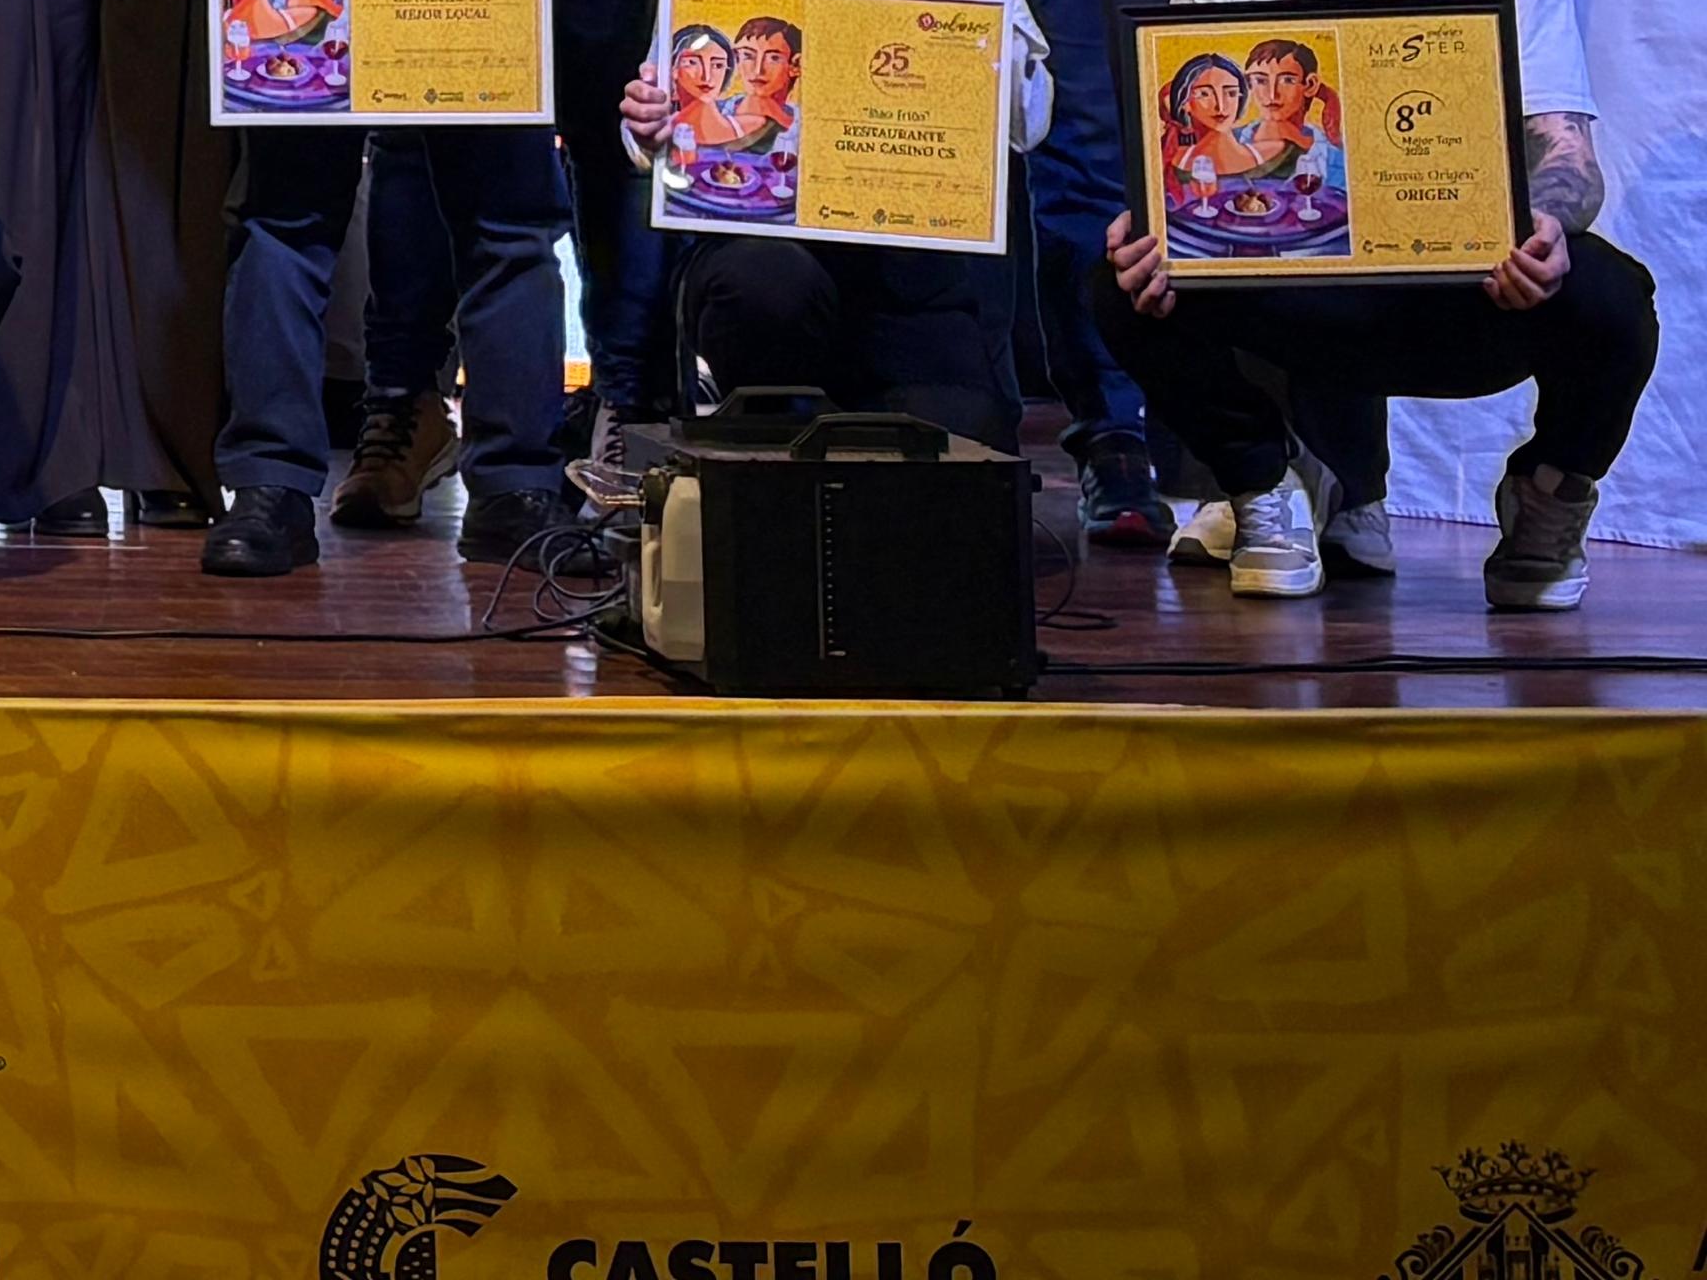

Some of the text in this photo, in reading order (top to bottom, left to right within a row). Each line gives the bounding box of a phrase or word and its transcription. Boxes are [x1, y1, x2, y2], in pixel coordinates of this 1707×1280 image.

[395, 7, 490, 20] MEJOR LOCAL
[1369, 34, 1465, 62] MASTER
[871, 48, 909, 77] 25
[843, 125, 946, 142] RESTAURANTE
[835, 141, 956, 159] GRAN CASINO CS
[1396, 187, 1459, 202] ORIGEN
